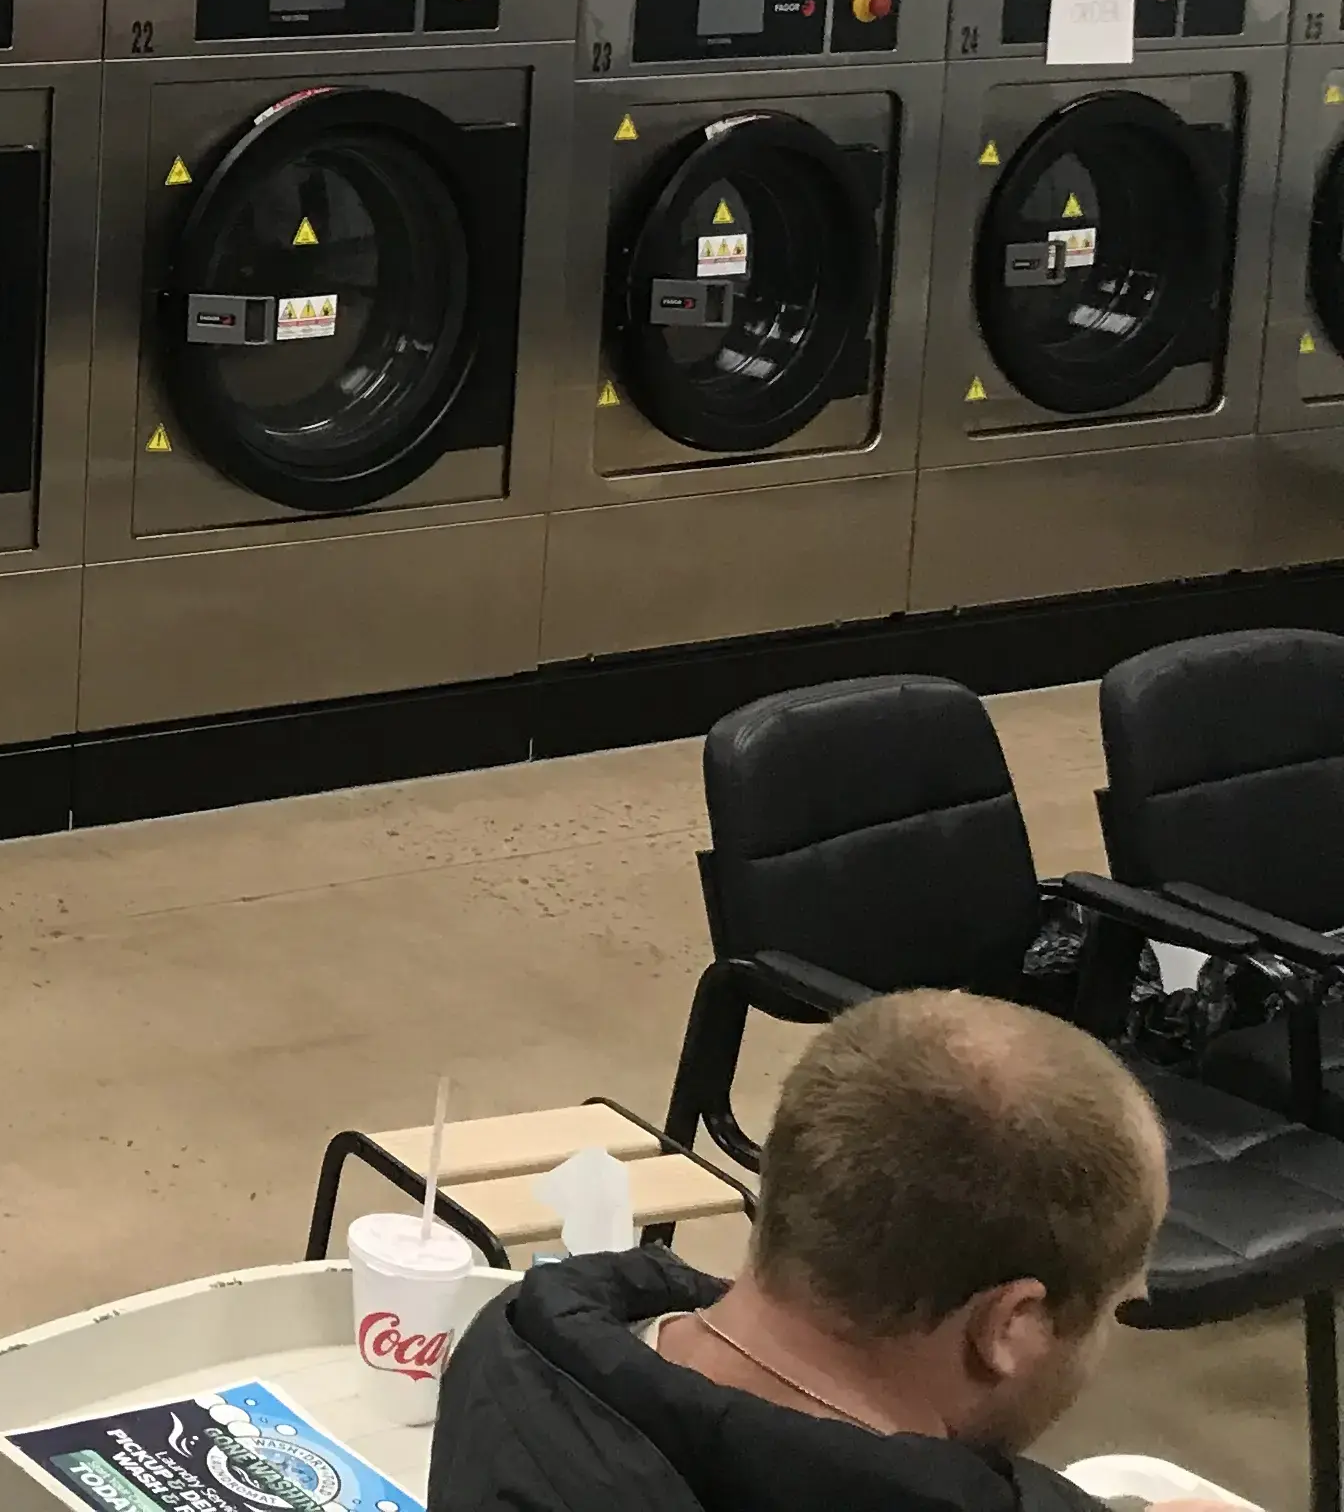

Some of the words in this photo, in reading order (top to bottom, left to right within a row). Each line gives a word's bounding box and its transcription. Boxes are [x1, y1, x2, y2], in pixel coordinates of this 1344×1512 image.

[774, 3, 800, 12] FAGOR
[132, 20, 153, 53] 22
[593, 42, 611, 72] 23
[106, 1428, 174, 1480] PICKUP
[167, 1479, 185, 1490] &
[204, 1427, 259, 1464] GONE
[254, 1438, 297, 1455] WASH
[112, 1451, 169, 1494] WASH
[155, 1451, 206, 1488] Laundry
